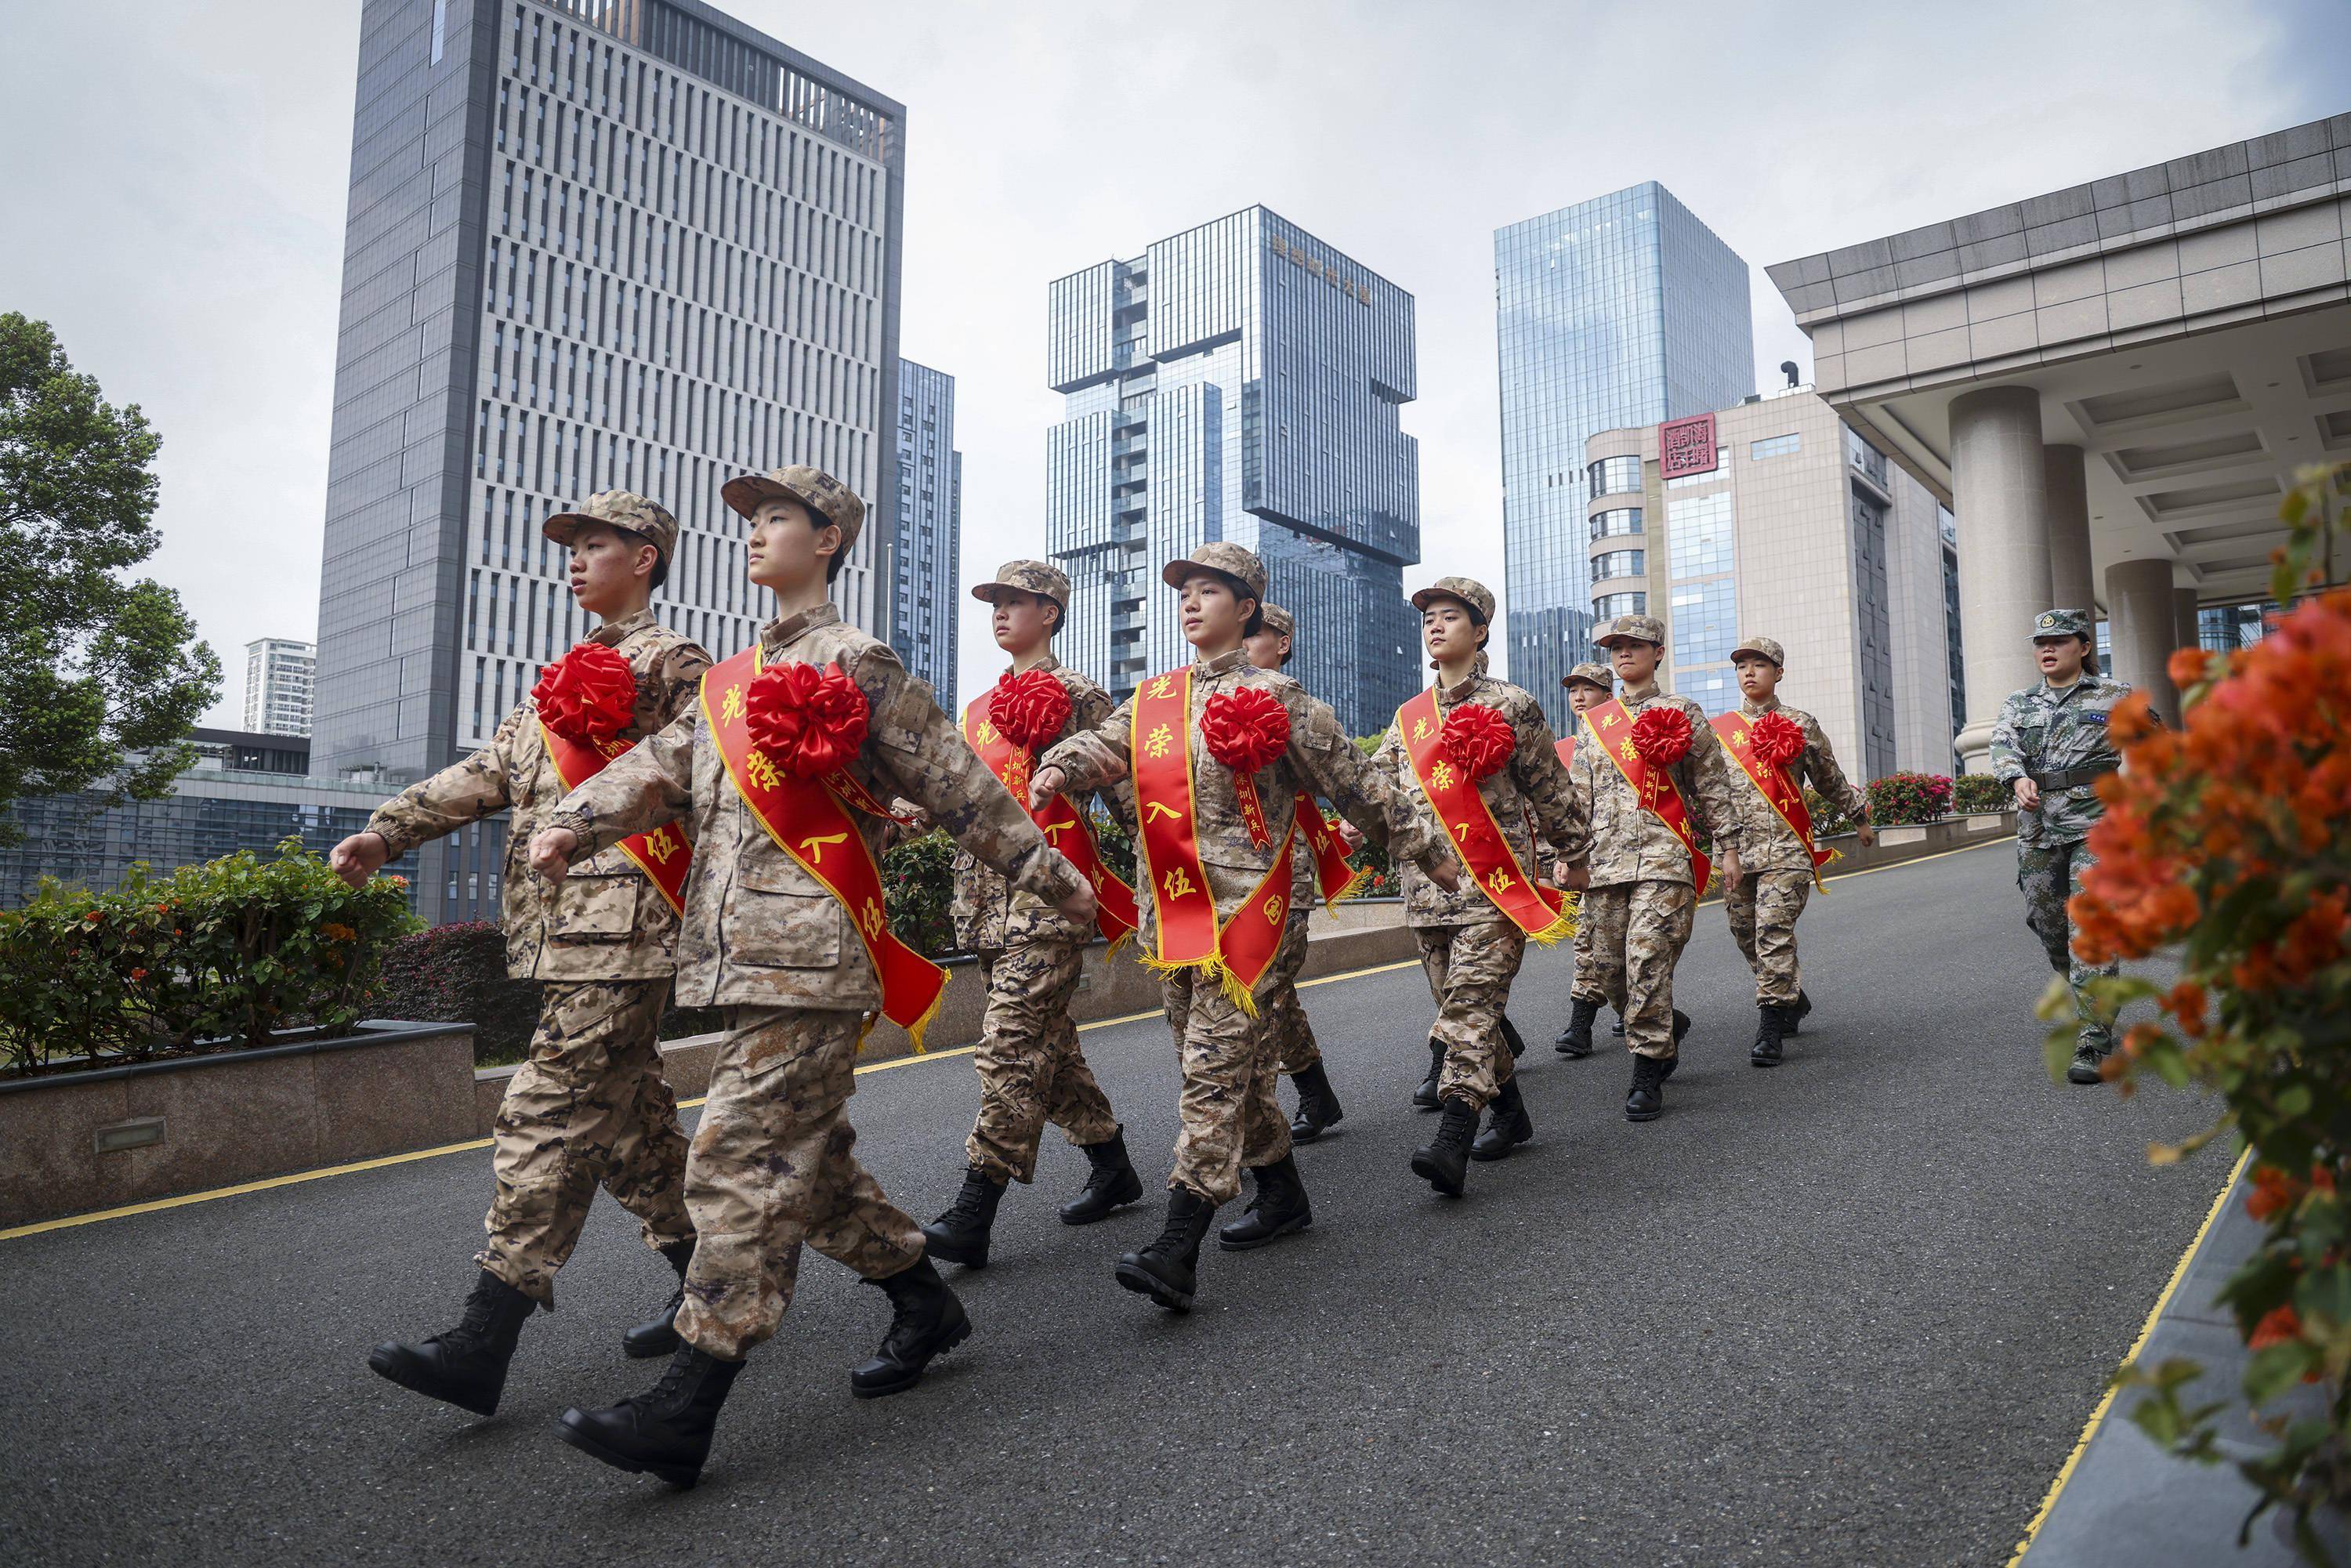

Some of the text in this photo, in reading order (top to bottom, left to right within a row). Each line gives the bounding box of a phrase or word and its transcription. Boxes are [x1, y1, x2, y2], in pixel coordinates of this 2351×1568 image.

[1143, 675, 1197, 901] 光荣入伍
[1236, 773, 1261, 833] 深圳新兵
